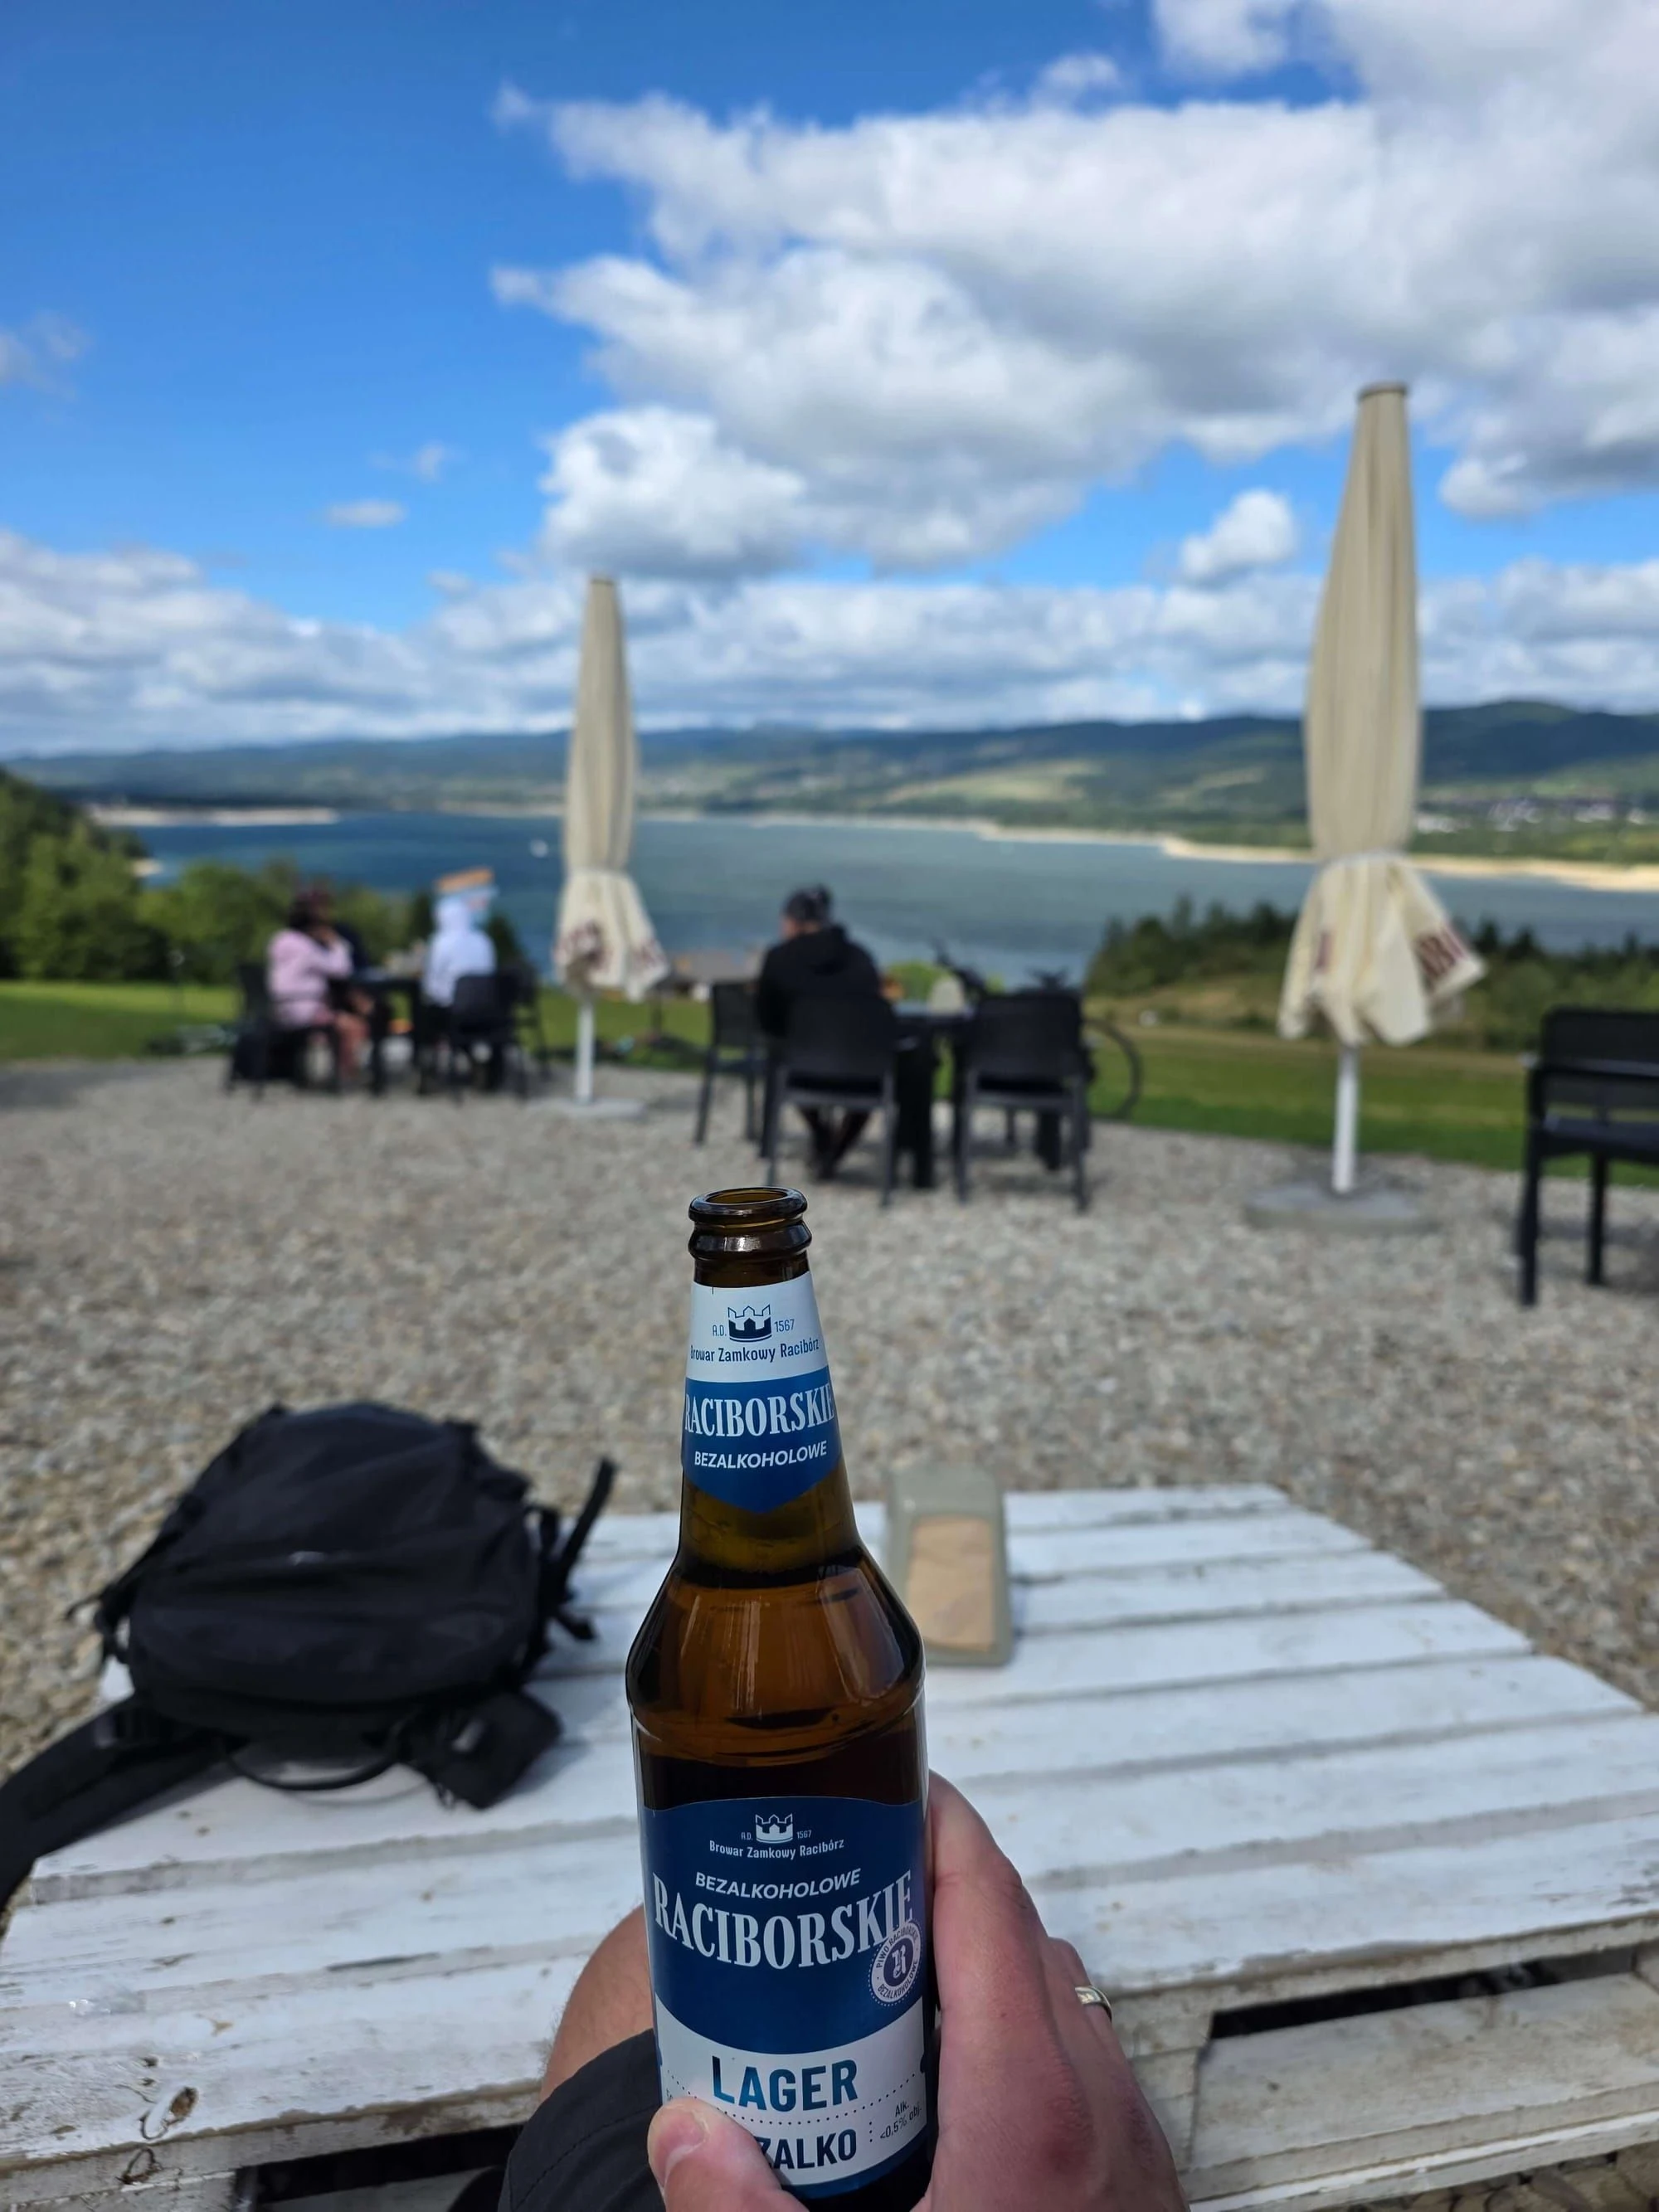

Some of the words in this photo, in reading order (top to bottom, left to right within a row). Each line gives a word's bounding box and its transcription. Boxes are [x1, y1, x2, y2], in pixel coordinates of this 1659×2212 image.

[774, 1319, 795, 1333] 1567
[690, 1344, 715, 1362] Browar
[718, 1347, 776, 1363] Zamkowy
[781, 1338, 820, 1358] Racibórz
[684, 1383, 834, 1437] RACIBORSKIE
[694, 1440, 827, 1469] BEZALKOHOLOWE
[796, 1830, 812, 1839] 1567
[709, 1840, 743, 1857] Browar
[747, 1846, 796, 1860] Zamkowy
[800, 1839, 844, 1856] Racibórz
[695, 1867, 862, 1899] BEZALKOHOLOWE
[653, 1869, 913, 1969] RACIBORSKIE
[876, 1945, 889, 1968] PIWO
[712, 2055, 859, 2112] LAGER
[895, 2100, 909, 2117] Alk.
